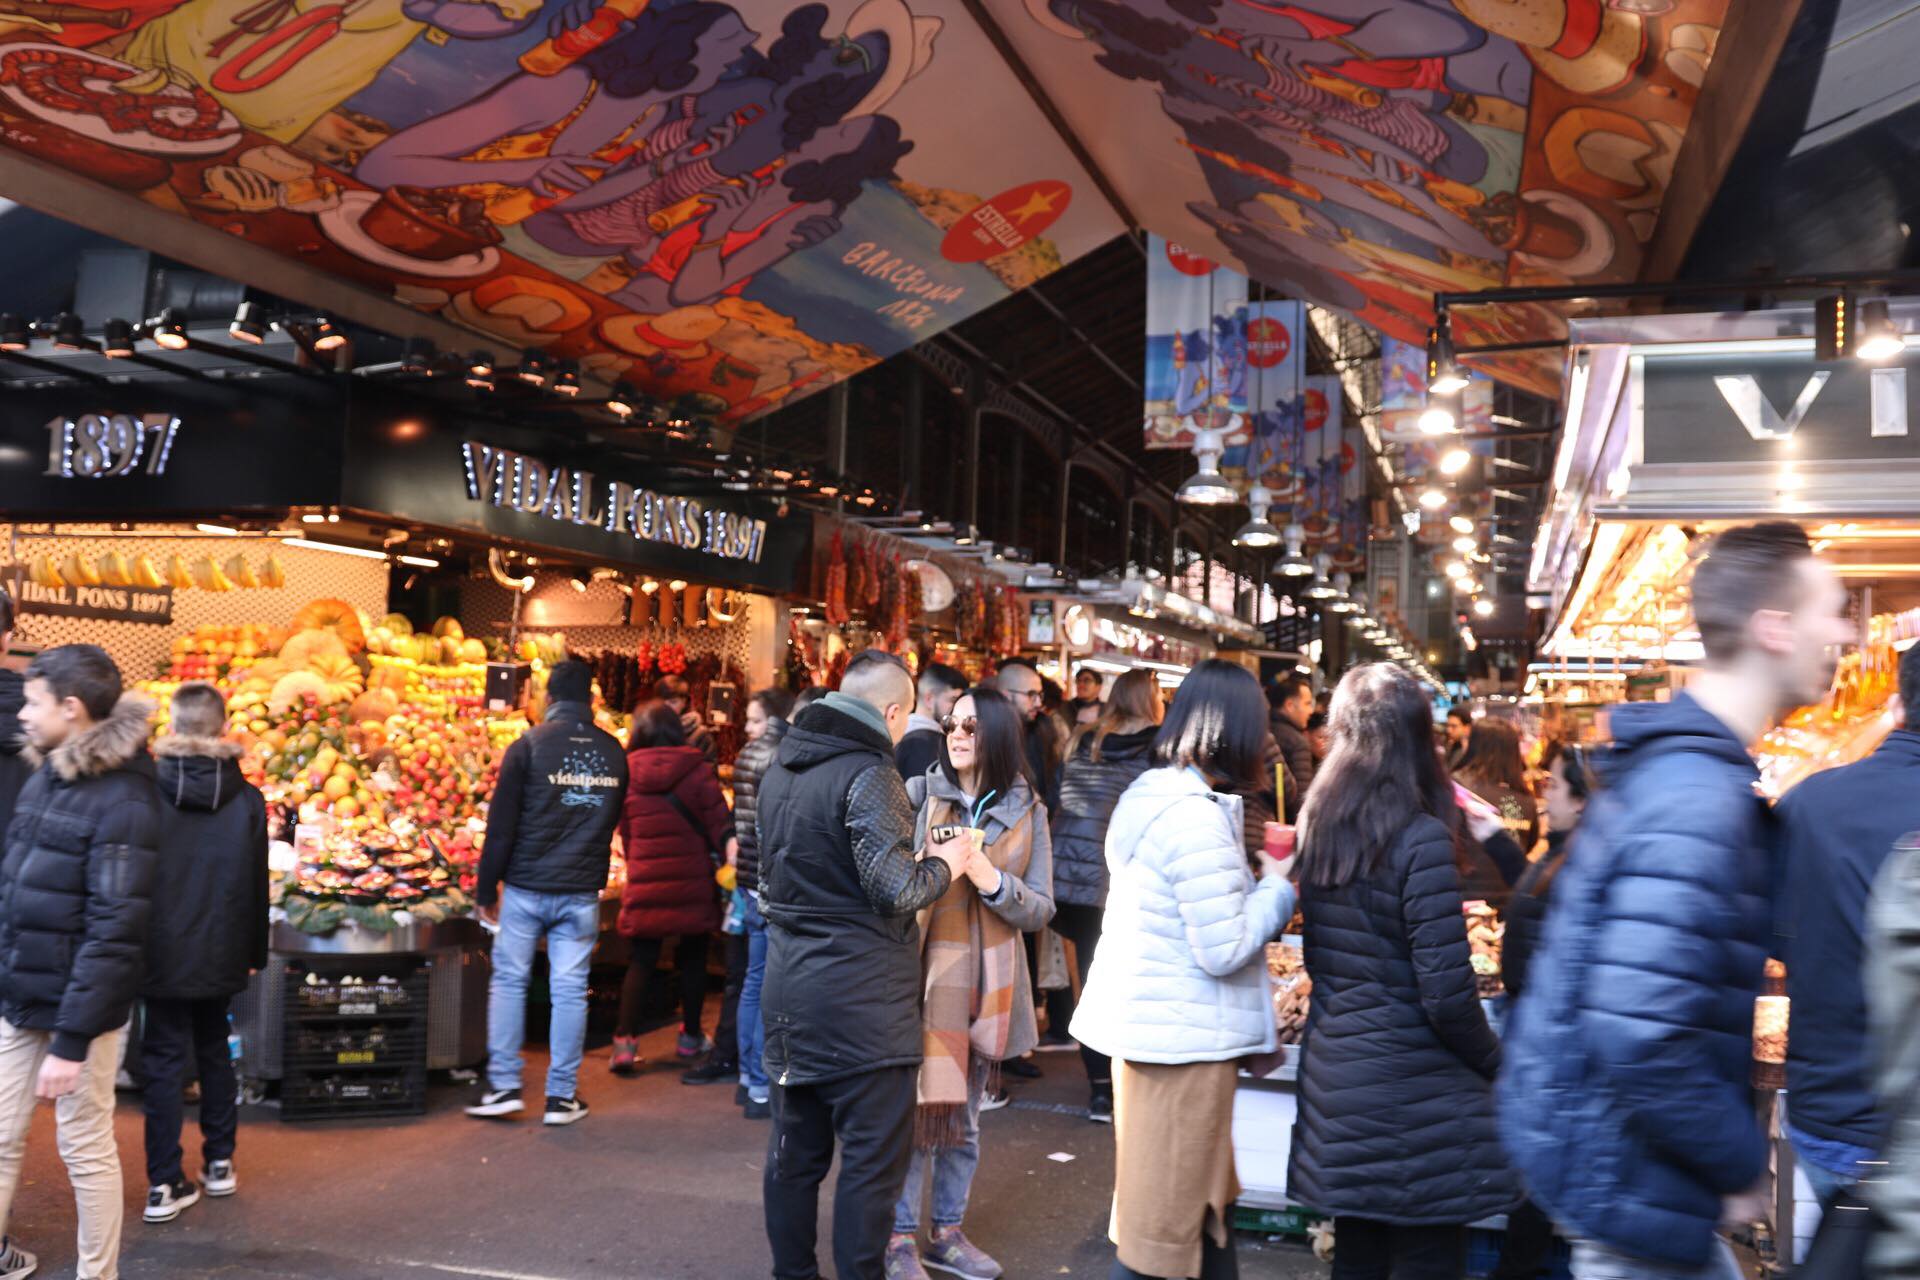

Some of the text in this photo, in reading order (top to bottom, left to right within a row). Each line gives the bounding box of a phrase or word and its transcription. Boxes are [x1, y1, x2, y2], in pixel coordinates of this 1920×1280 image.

[972, 204, 1024, 249] ESTRELLA
[43, 413, 182, 479] 1897
[462, 441, 767, 565] VIDAL PONS 1897
[76, 585, 128, 611] PONS
[132, 592, 170, 615] 1897
